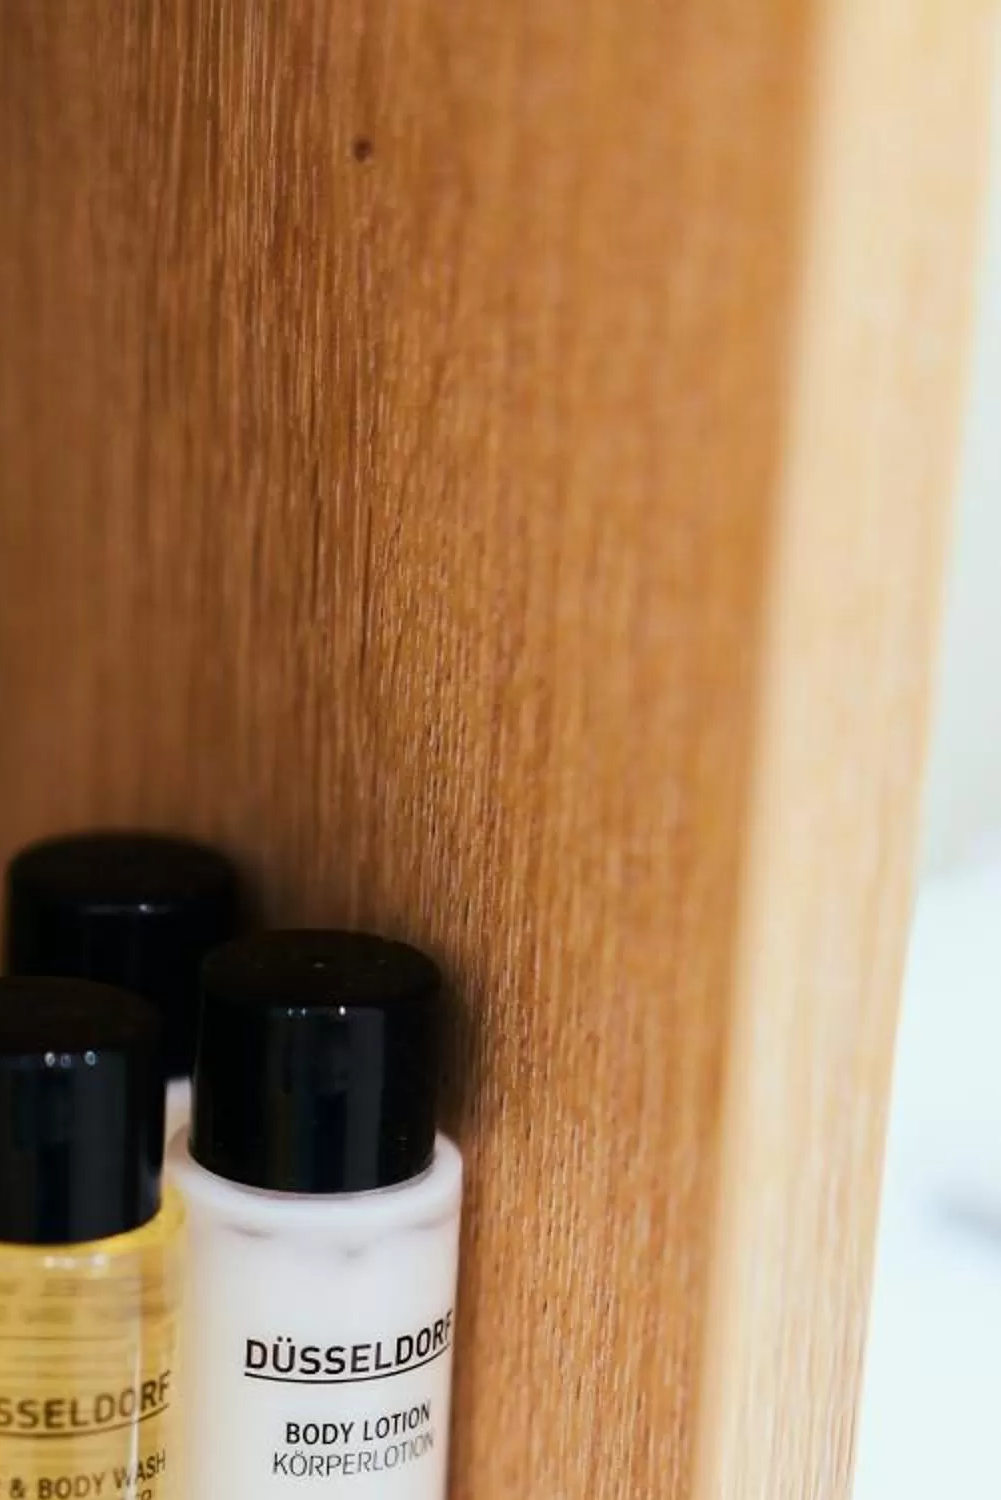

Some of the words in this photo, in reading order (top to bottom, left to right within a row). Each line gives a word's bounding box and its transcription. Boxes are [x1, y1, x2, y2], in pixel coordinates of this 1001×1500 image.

[244, 1308, 454, 1376] DÜSSELDORF
[285, 1421, 356, 1445] BODY
[362, 1400, 432, 1442] LOTION
[8, 1476, 27, 1500] &
[37, 1472, 106, 1500] BODY
[112, 1448, 167, 1490] WASH
[272, 1428, 435, 1477] KÖRPERLOTION
